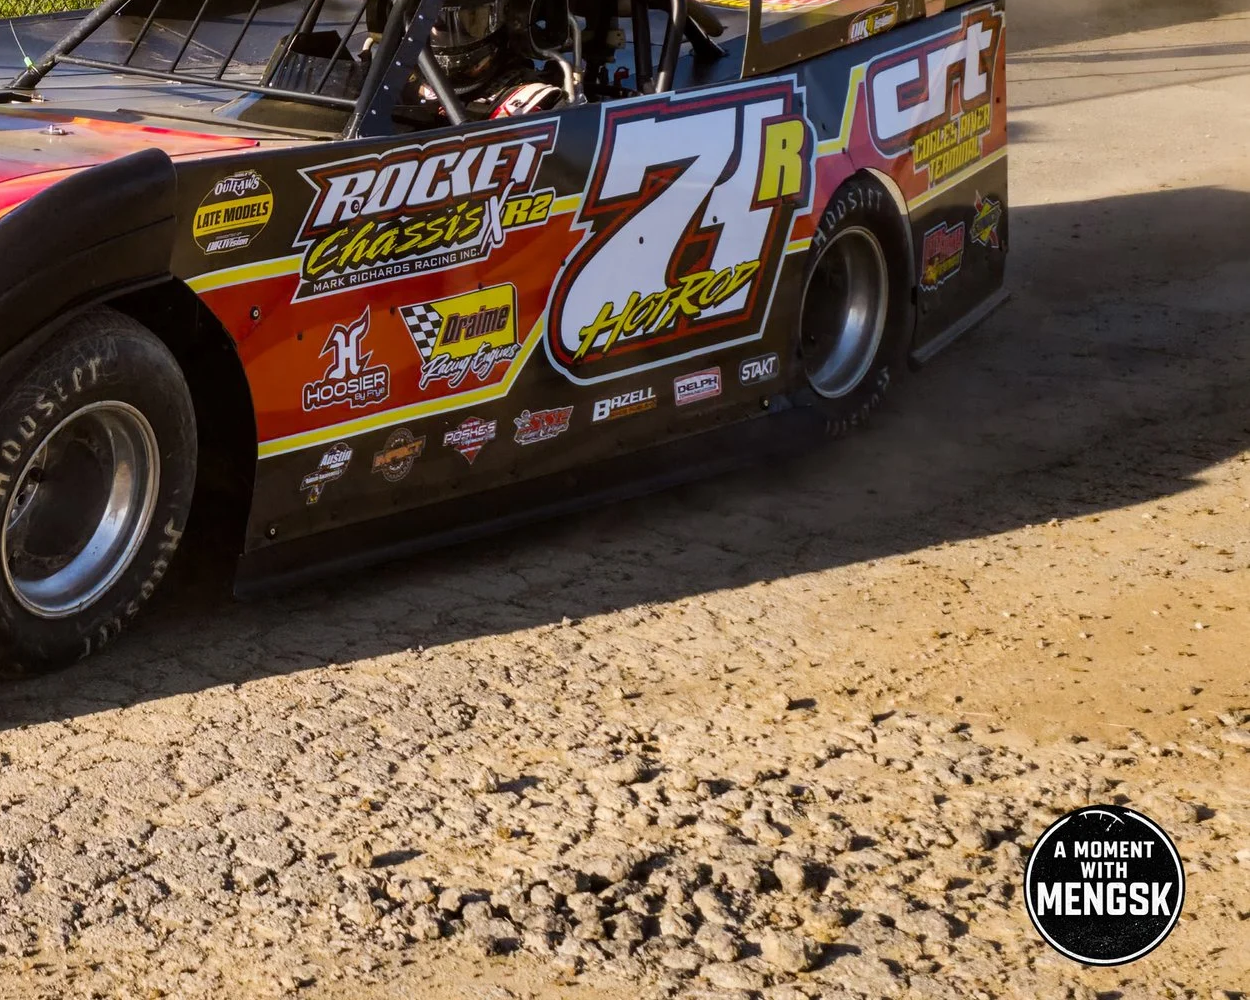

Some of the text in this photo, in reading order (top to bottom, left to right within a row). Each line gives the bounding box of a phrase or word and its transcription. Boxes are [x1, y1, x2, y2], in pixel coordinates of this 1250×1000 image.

[313, 134, 549, 228] ROCKET
[196, 201, 270, 229] LATE MODELS
[306, 201, 483, 275] Chassis
[313, 247, 480, 293] MARK RICHARDS RACING INC.
[439, 304, 511, 346] Draime
[421, 342, 518, 388] Racing Engines
[677, 376, 718, 394] DELPH
[307, 372, 386, 404] HOOSIER
[592, 387, 656, 421] BAZELL
